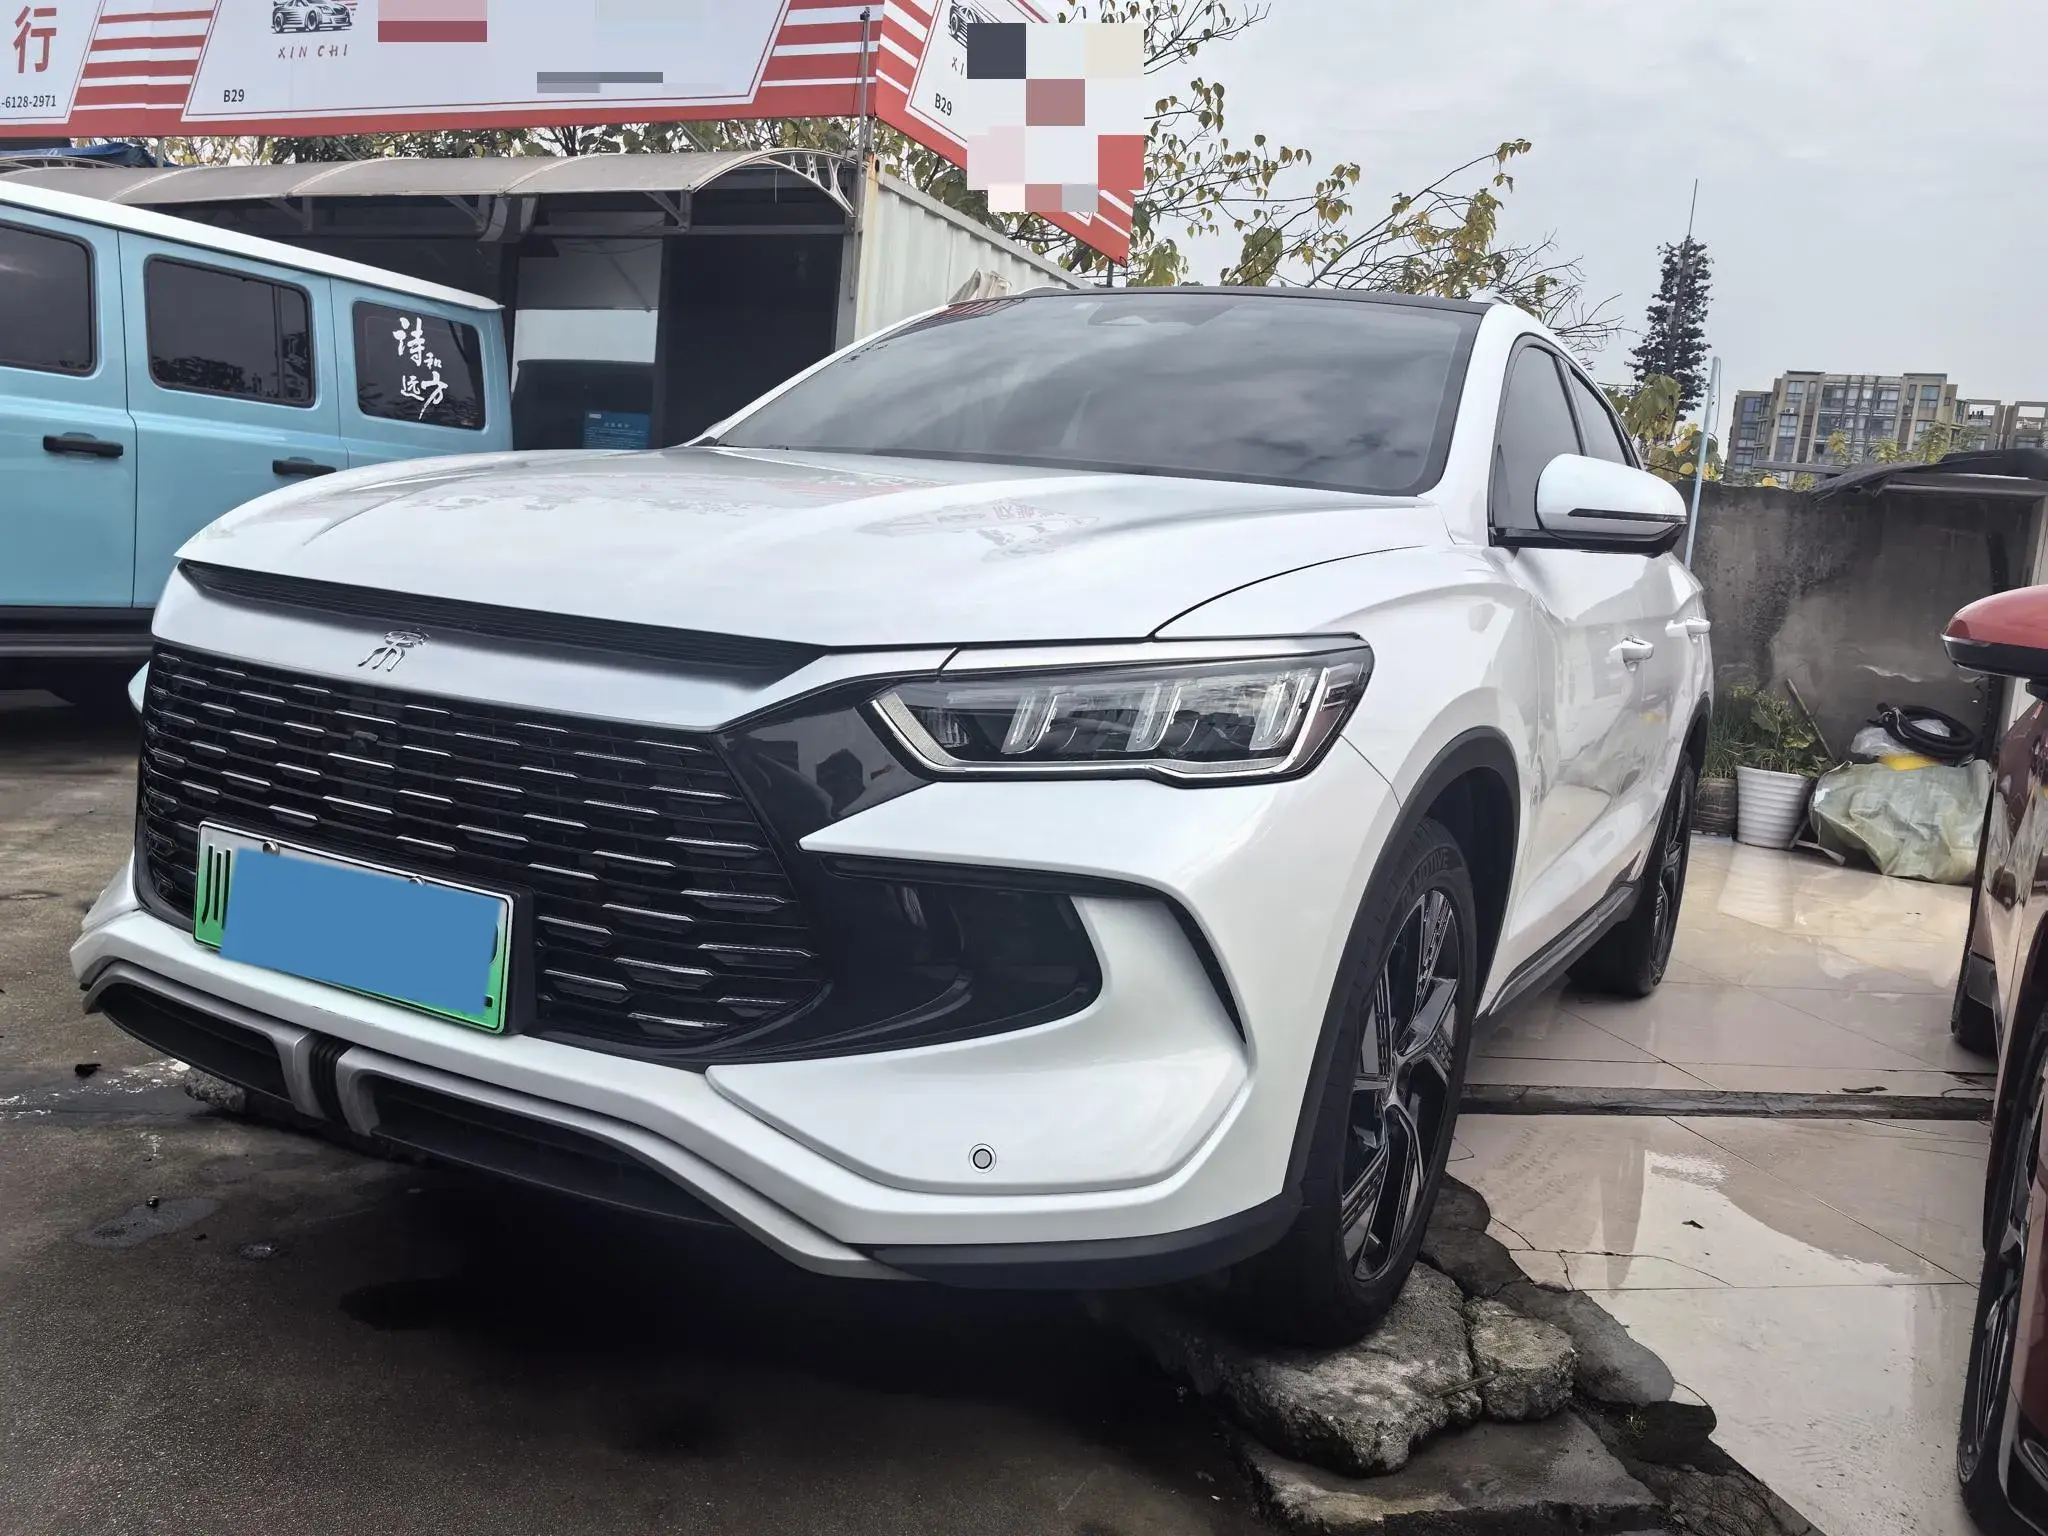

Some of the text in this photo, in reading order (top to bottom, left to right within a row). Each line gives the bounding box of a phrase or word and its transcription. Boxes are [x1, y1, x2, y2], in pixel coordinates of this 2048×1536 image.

[13, 6, 57, 74] 行
[277, 44, 348, 59] XIN CHI
[223, 88, 245, 103] B29
[934, 92, 952, 117] B29
